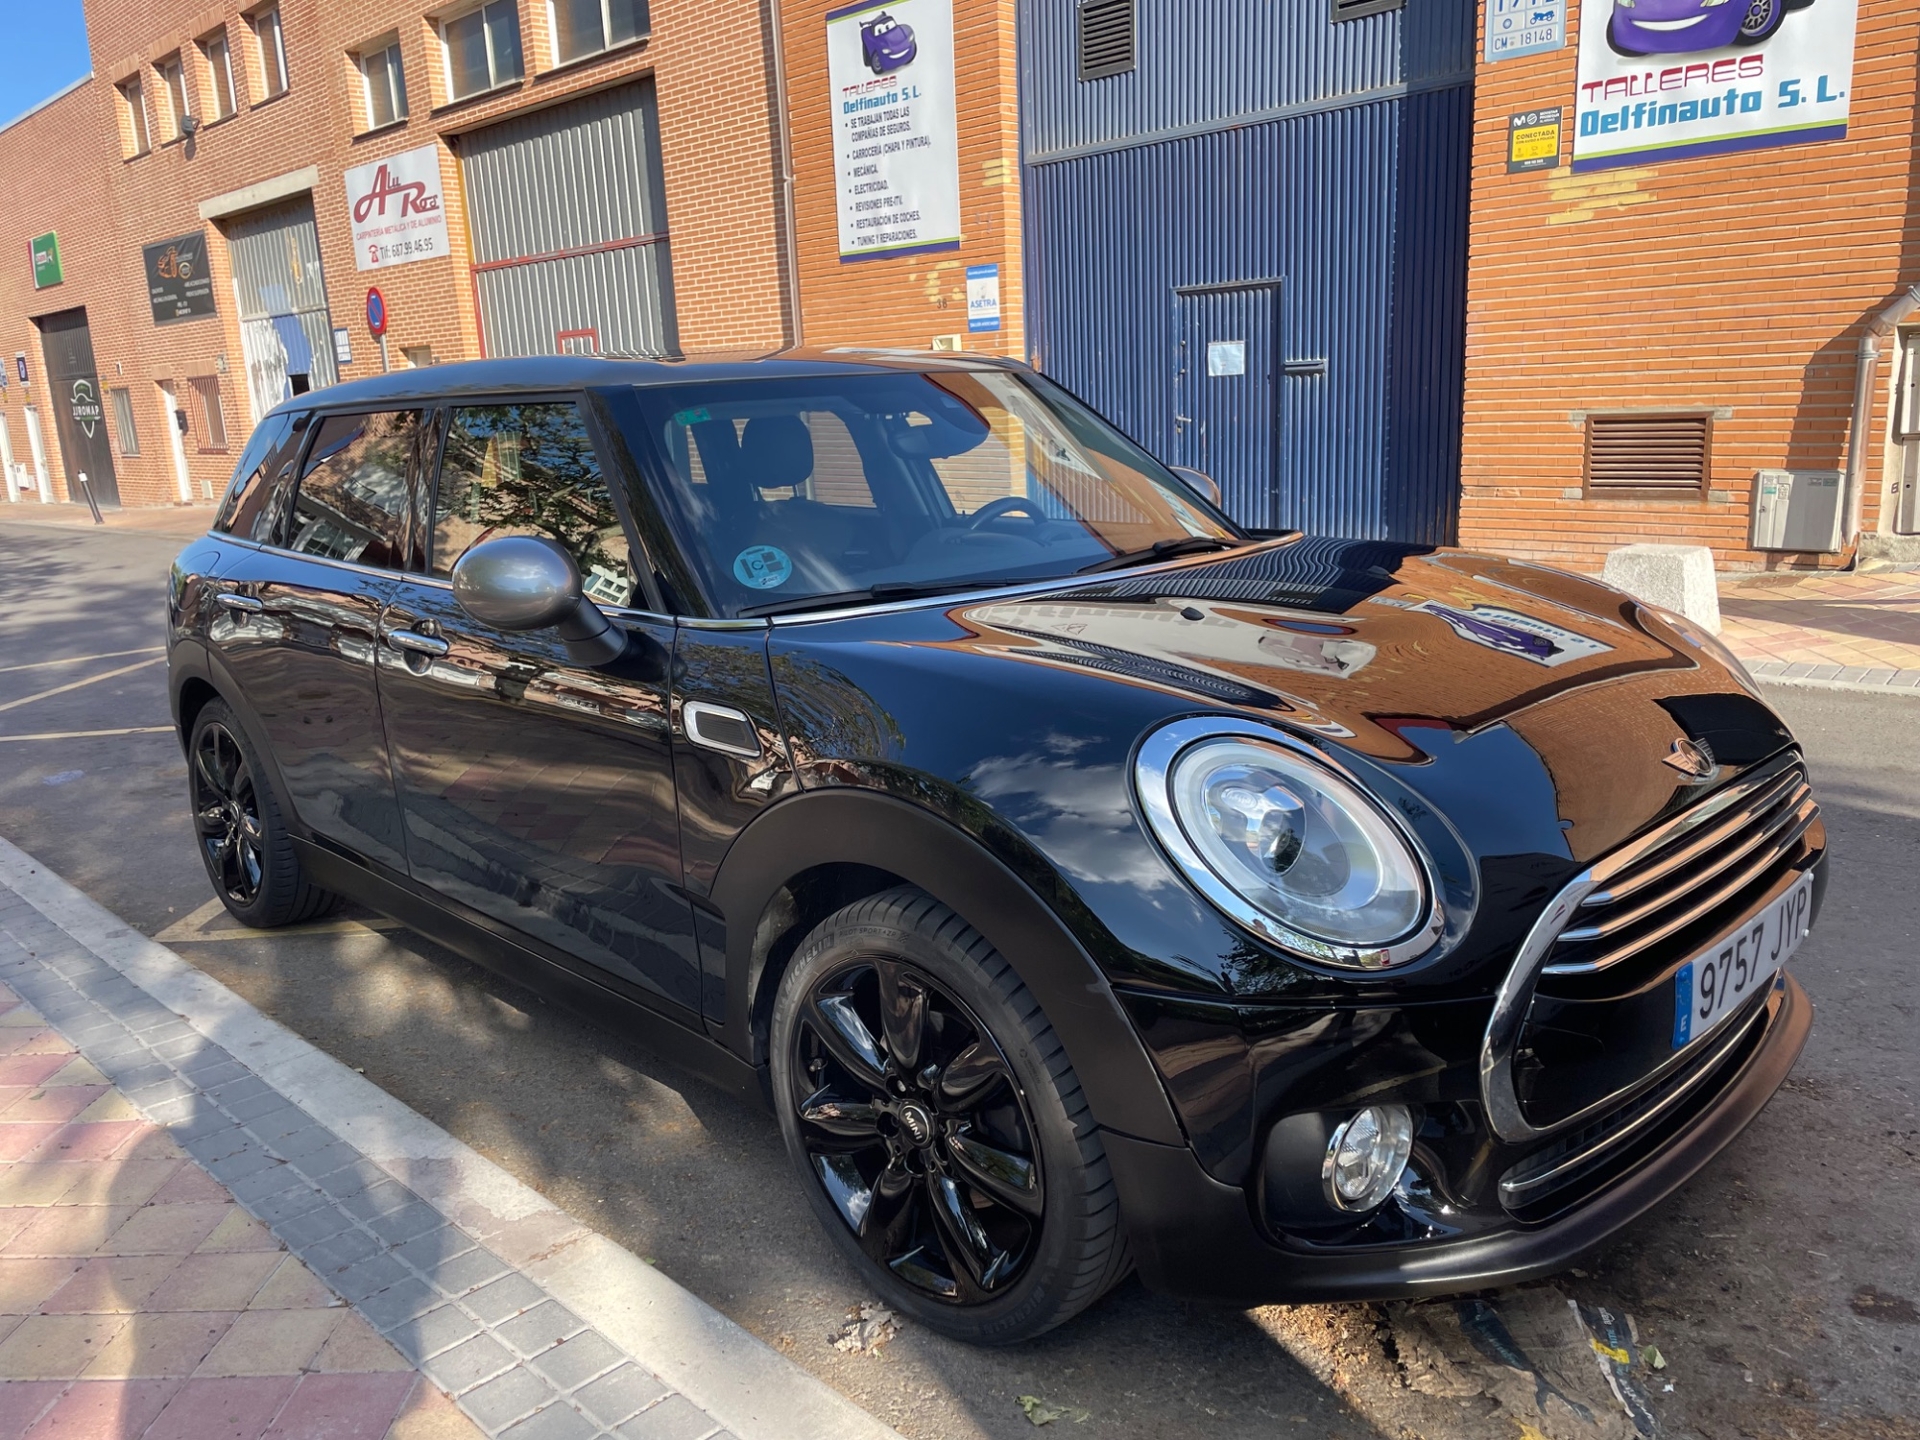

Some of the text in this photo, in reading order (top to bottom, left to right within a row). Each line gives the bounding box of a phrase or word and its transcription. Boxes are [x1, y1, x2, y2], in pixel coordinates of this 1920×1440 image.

[1520, 28, 1552, 46] 18148
[842, 76, 897, 98] TALLERES
[1582, 54, 1764, 102] TALLERES
[844, 92, 898, 114] Delfinauto
[1580, 88, 1763, 137] Delfinauto
[850, 118, 857, 128] SE
[900, 106, 910, 118] LAS
[880, 126, 886, 136] DE
[1516, 130, 1554, 140] CONECTADA
[892, 214, 899, 224] DE
[970, 298, 997, 308] ASETRA
[1700, 886, 1808, 1020] 9757 JYP
[785, 935, 832, 995] MICHELIN
[1680, 1014, 1687, 1032] E
[905, 1110, 923, 1140] MINI
